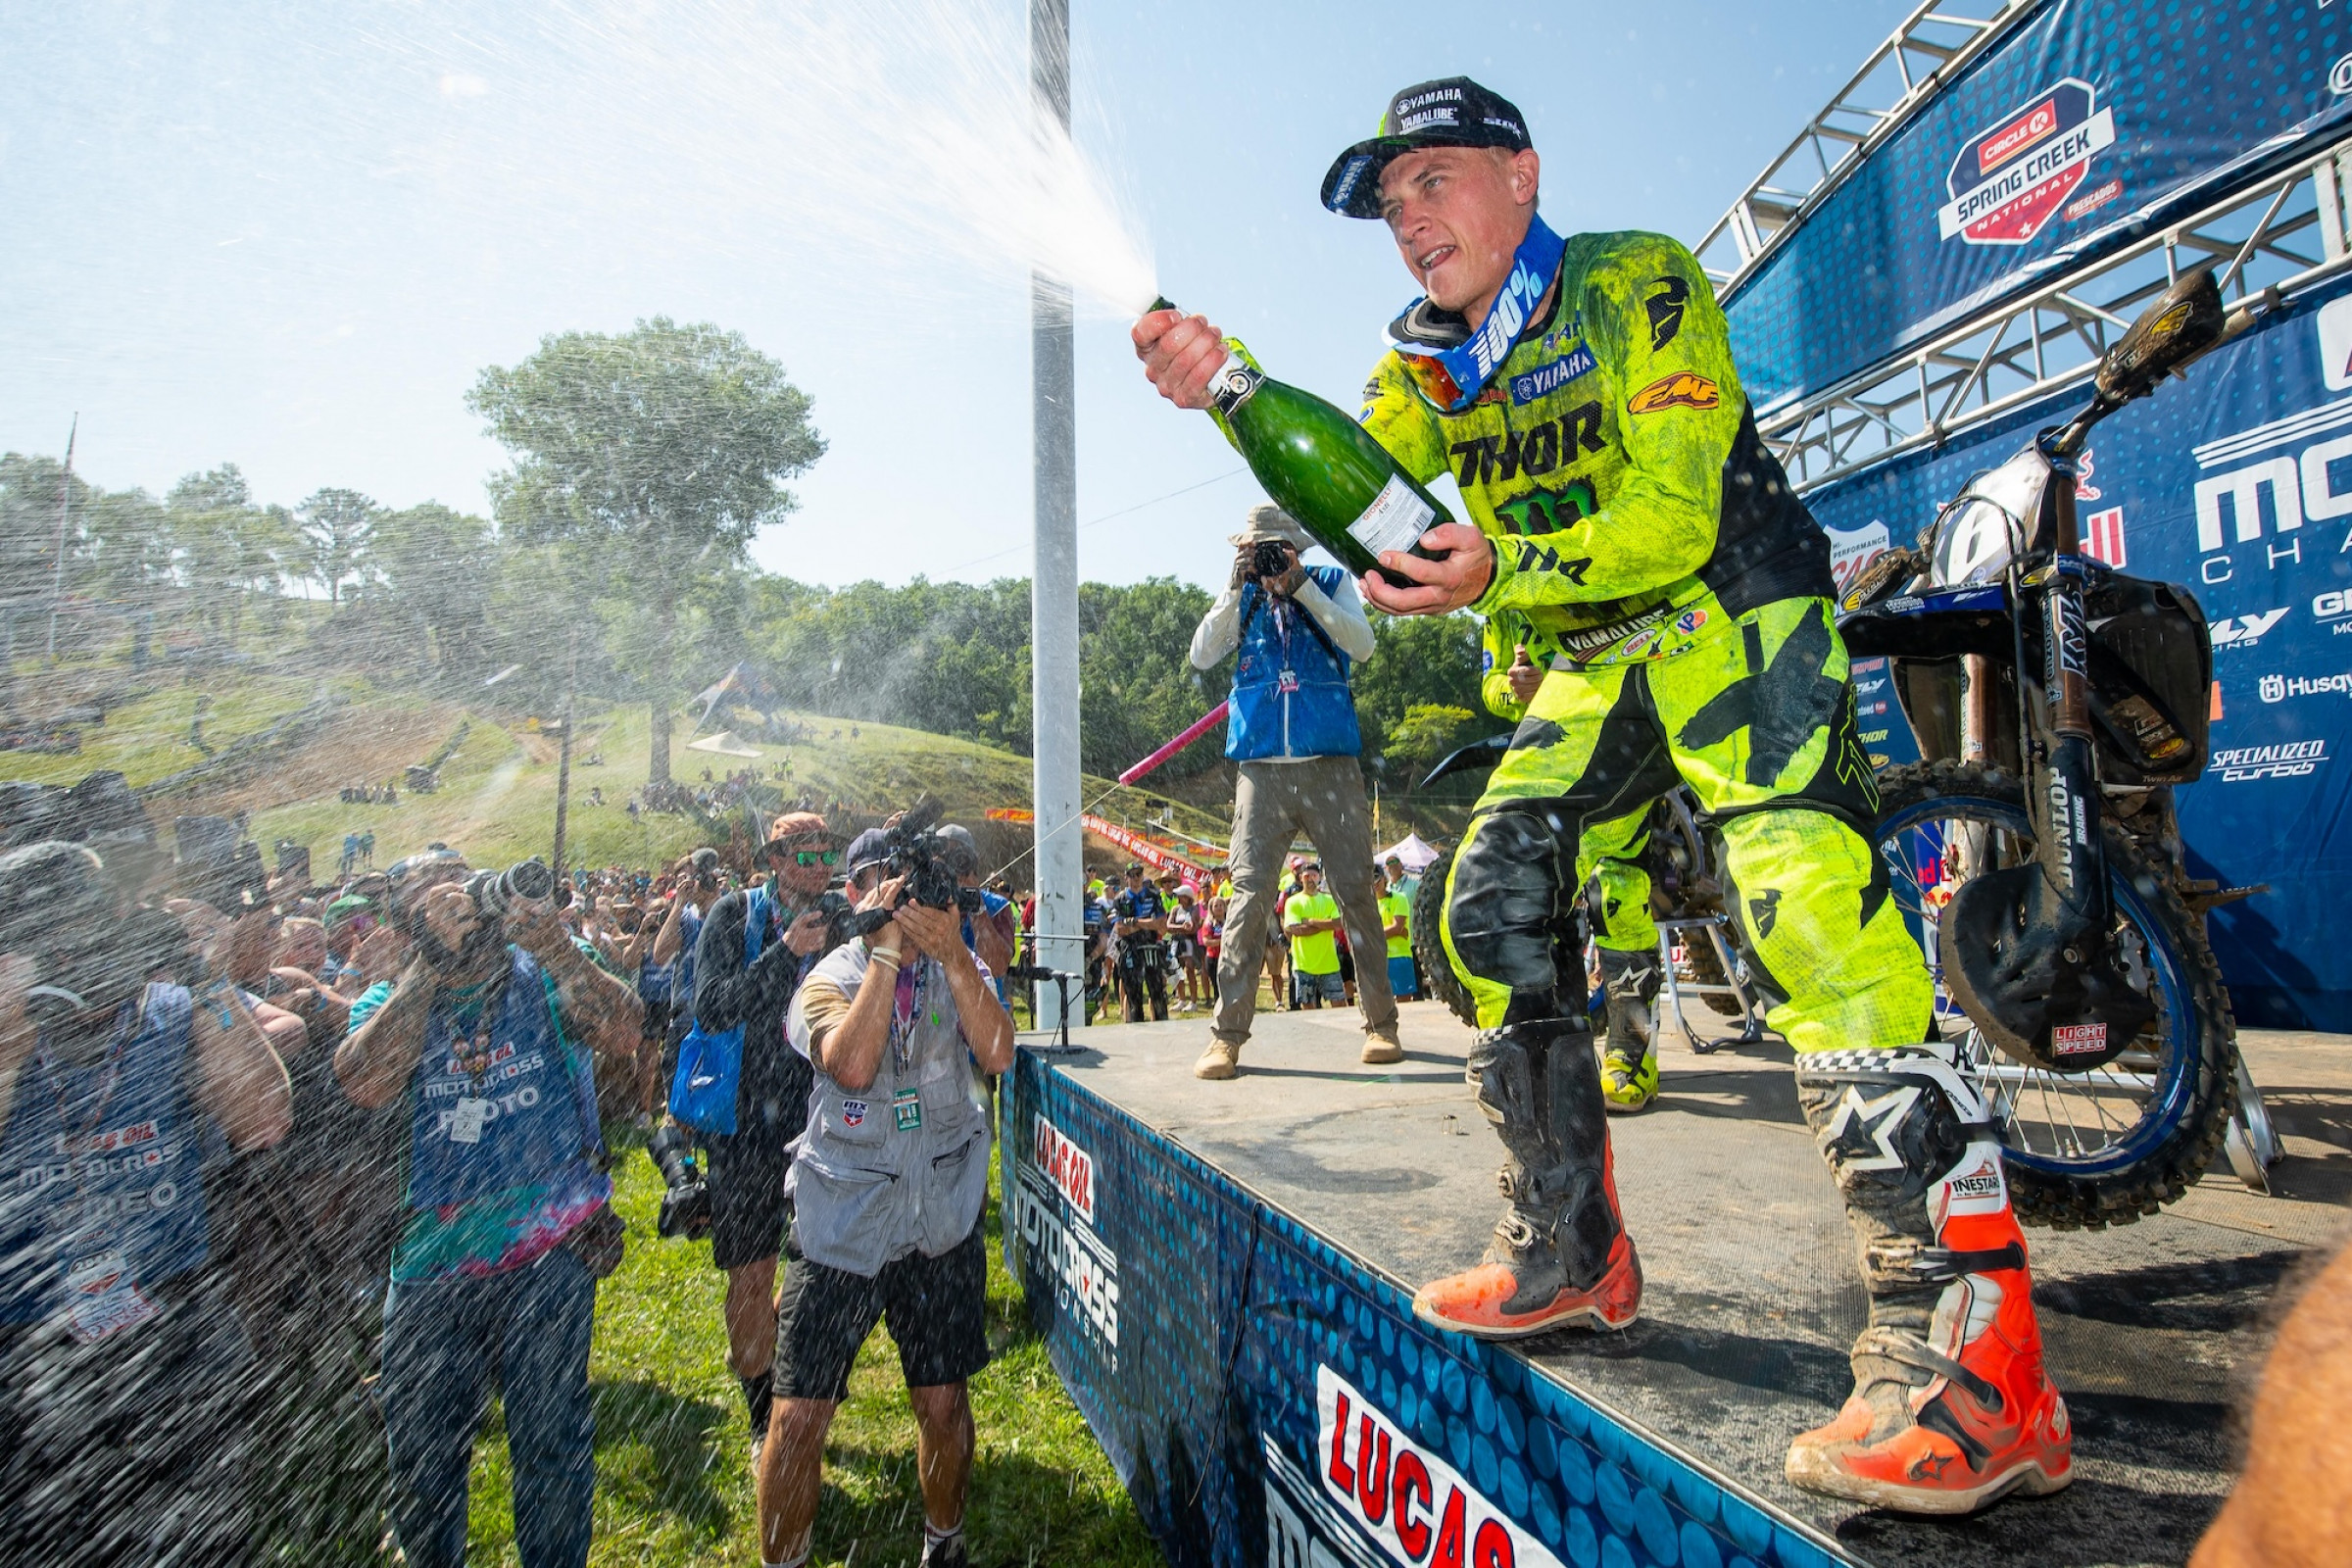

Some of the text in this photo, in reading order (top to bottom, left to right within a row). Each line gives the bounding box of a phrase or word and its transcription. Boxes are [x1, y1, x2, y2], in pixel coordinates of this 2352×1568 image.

[1410, 87, 1462, 109] YAMAHA
[1400, 108, 1455, 129] YAMALUBE
[1984, 112, 2048, 160] CIRCLE K
[1958, 126, 2090, 223] SPRING CREEK
[1976, 173, 2074, 233] NATIONAL
[1468, 259, 1544, 379] 100%
[1533, 351, 1592, 394] YAMAHA
[1449, 399, 1608, 488] THOR
[1833, 534, 1887, 560] PERFORMANCE
[1677, 612, 1696, 633] VP
[2208, 607, 2291, 646] LY
[1857, 728, 1889, 744] THOR
[2212, 739, 2326, 767] SPECIALIZED
[2142, 774, 2183, 783] Twin Air
[2223, 761, 2316, 782] turbo
[2049, 766, 2075, 889] DUNLOP
[2073, 795, 2087, 846] BRAKING
[1917, 858, 1936, 884] ed
[2054, 1024, 2106, 1040] LIGHT
[2054, 1039, 2106, 1054] SPEED
[438, 1085, 540, 1127] POTO
[1037, 1122, 1091, 1213] LUCAS OIL
[1952, 1176, 2000, 1193] INESTAR
[1014, 1179, 1120, 1348] MOTOCROSS
[1013, 1229, 1119, 1375] CAMPIONSHIP
